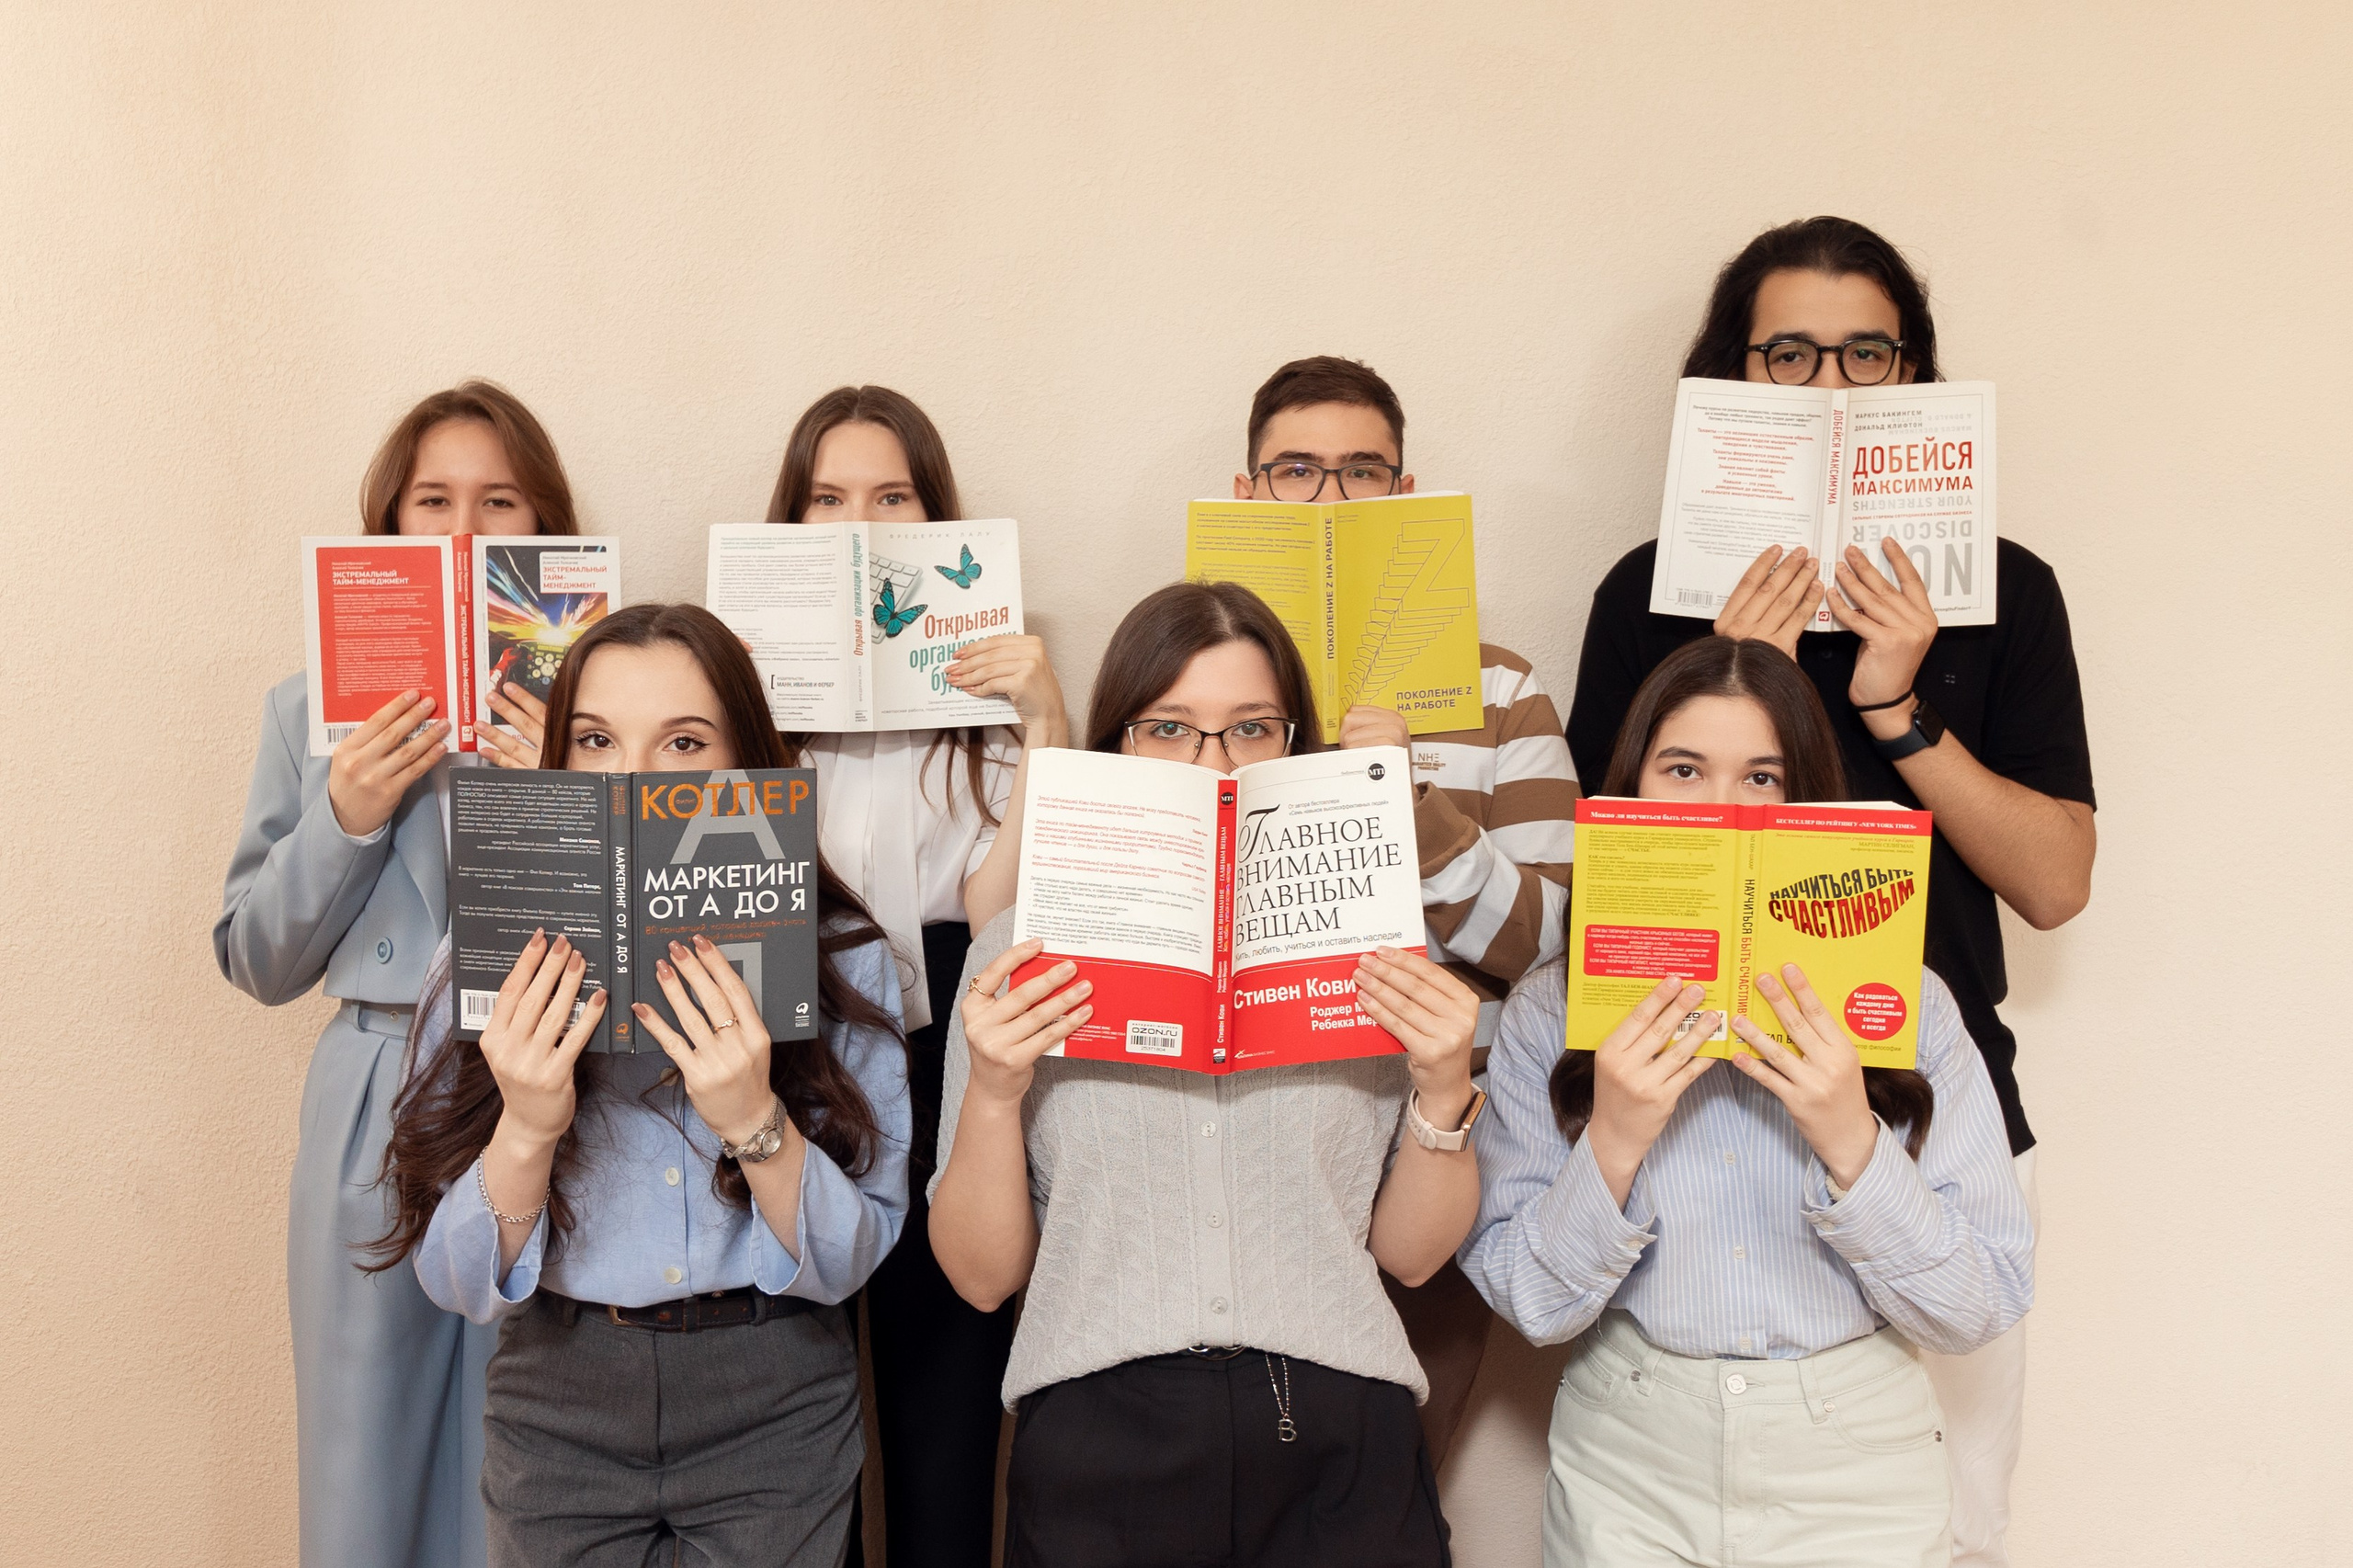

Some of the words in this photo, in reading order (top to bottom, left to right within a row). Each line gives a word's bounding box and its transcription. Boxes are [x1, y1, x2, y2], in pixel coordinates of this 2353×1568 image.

[1882, 410, 1922, 418] БАКИНГЕМ
[1831, 409, 1844, 448] ДОБЕЙСЯ
[1887, 422, 1923, 430] КЛИФТОН
[1852, 436, 1972, 480] ДОБЕЙСЯ
[1826, 450, 1841, 506] МАКСИМУМА
[1852, 476, 1973, 496] МАКСИМУМА
[1853, 496, 1933, 511] STRENGTHS
[1938, 494, 1972, 506] YOUR
[1324, 517, 1333, 561] РАБОТЕ
[1853, 519, 1972, 542] DISCOVER
[851, 533, 863, 568] будущего
[333, 570, 397, 579] ЭКСТРЕМАЛЬНЫЙ
[333, 577, 409, 585] ТАЙМ-МЕНЕДЖМЕНТ
[543, 565, 607, 574] ЭКСТРЕМАЛЬНЫЙ
[1325, 563, 1334, 578] НА
[853, 571, 865, 617] организации
[924, 606, 1009, 640] Открывая
[1325, 591, 1335, 659] ПОКОЛЕНИЕ
[853, 619, 866, 656] Открывая
[1396, 687, 1463, 699] ПОКОЛЕНИЕ
[1465, 687, 1472, 695] Z
[1397, 703, 1412, 711] НА
[1415, 699, 1456, 710] РАБОТЕ
[641, 779, 811, 821] КОТЛЕР
[1662, 813, 1680, 822] быть
[1776, 817, 1815, 825] БЕСТСЕЛЛЕР
[1825, 819, 1858, 827] РЕЙТИНГУ
[615, 846, 627, 908] МАРКЕТИНГ
[643, 861, 811, 892] МАРКЕТИНГ
[1237, 843, 1403, 892] ВНИМАНИЕ
[1769, 869, 1864, 900] НАУЧИТЬСЯ
[1865, 868, 1914, 890] БЫТЬ
[648, 894, 689, 920] ОТ
[699, 892, 722, 917] А
[733, 890, 779, 920] ДО
[790, 888, 806, 912] Я
[1235, 874, 1376, 921] ГЛАВНЫМ
[1742, 879, 1756, 934] НАУЧИТЬСЯ
[1768, 878, 1915, 939] СЧАСТЛИВЫМ
[616, 913, 628, 930] ОТ
[644, 926, 657, 936] 80
[1235, 907, 1342, 947] ВЕЩАМ
[616, 933, 627, 942] А
[1251, 944, 1282, 958] любить,
[1283, 939, 1316, 954] учиться
[1324, 937, 1362, 948] оставить
[1362, 930, 1403, 943] наследие
[615, 945, 629, 963] ДО
[1741, 937, 1752, 963] БЫТЬ
[617, 965, 629, 974] Я
[1233, 984, 1302, 1010] Стивен
[1305, 977, 1358, 999] Кови
[1217, 1004, 1225, 1019] Кови
[1310, 1004, 1353, 1017] Роджер
[1867, 1009, 1903, 1017] счастливым
[1217, 1020, 1225, 1043] Стивен
[1312, 1017, 1356, 1031] Ребекка
